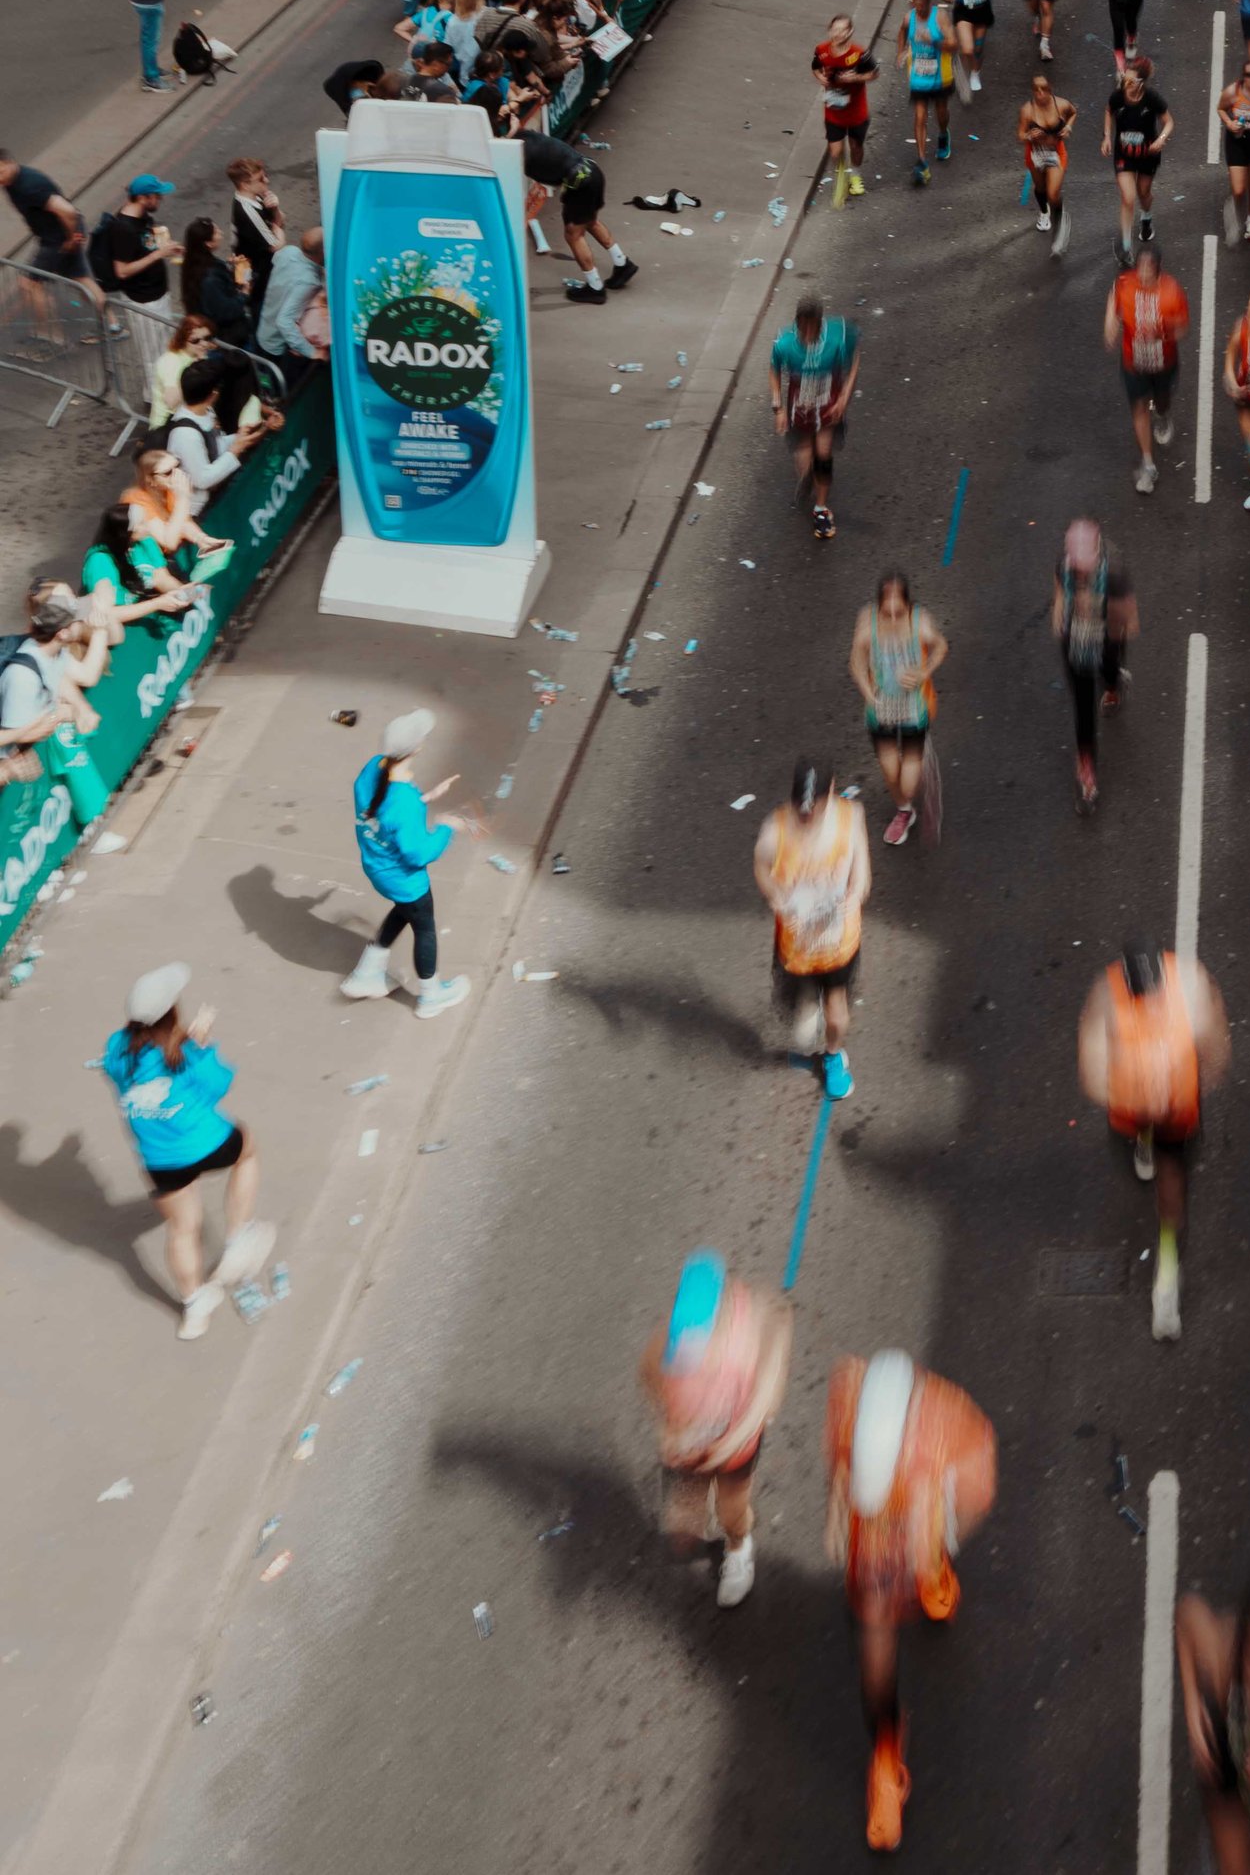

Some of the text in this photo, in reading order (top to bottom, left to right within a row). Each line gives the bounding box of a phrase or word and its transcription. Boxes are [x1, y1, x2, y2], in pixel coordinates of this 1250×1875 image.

[386, 300, 470, 325] MINERAL
[366, 338, 491, 368] RADOX
[391, 383, 471, 405] THERAPY
[411, 411, 446, 424] FEEL
[398, 422, 461, 440] AWAKE
